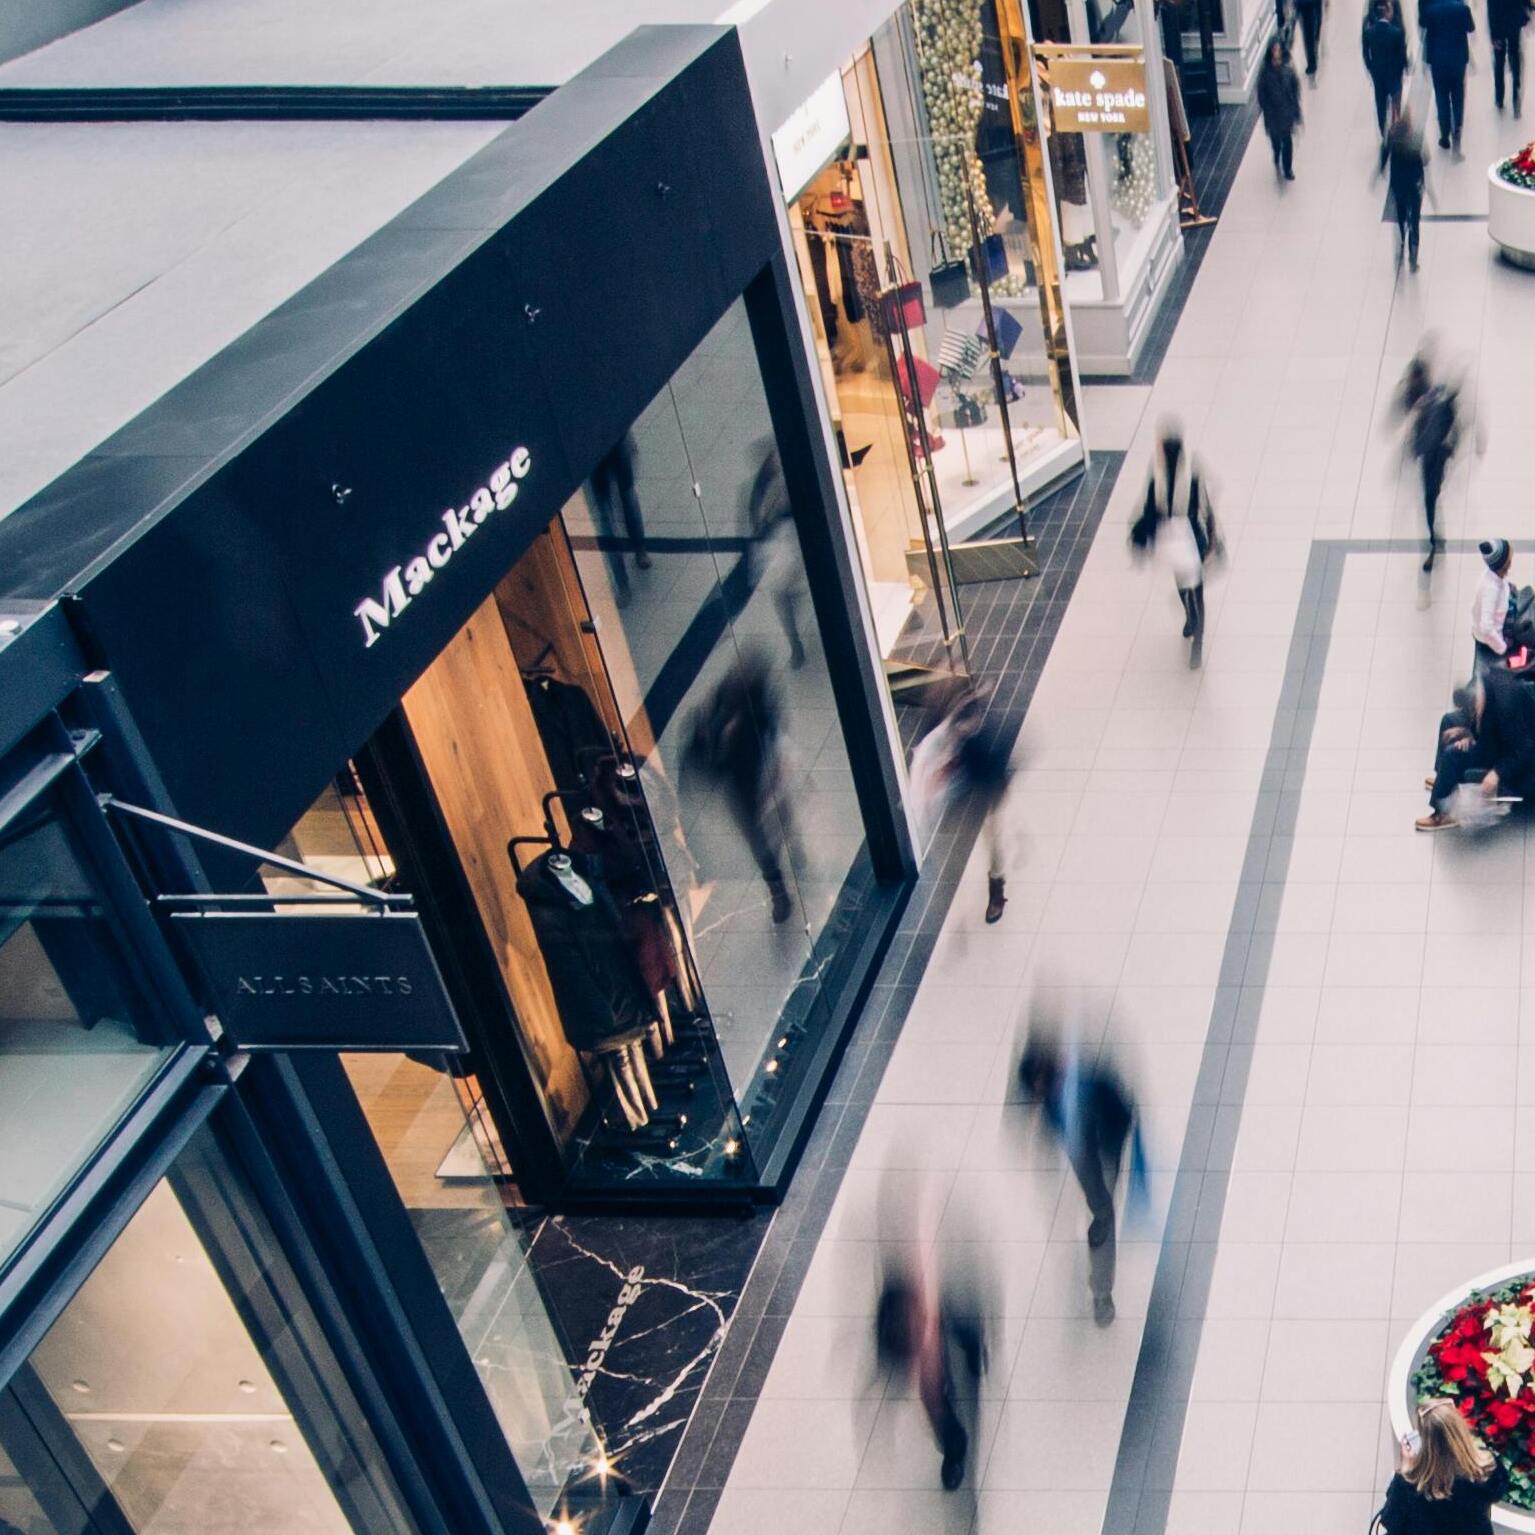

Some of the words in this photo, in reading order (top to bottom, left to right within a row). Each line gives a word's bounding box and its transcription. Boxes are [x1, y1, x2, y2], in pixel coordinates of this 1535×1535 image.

[1054, 86, 1092, 107] kate
[1096, 87, 1146, 112] spade
[1078, 111, 1099, 123] NEW
[1101, 111, 1126, 124] YORK
[354, 446, 532, 648] Mackage
[236, 975, 413, 995] ALLSAINTS
